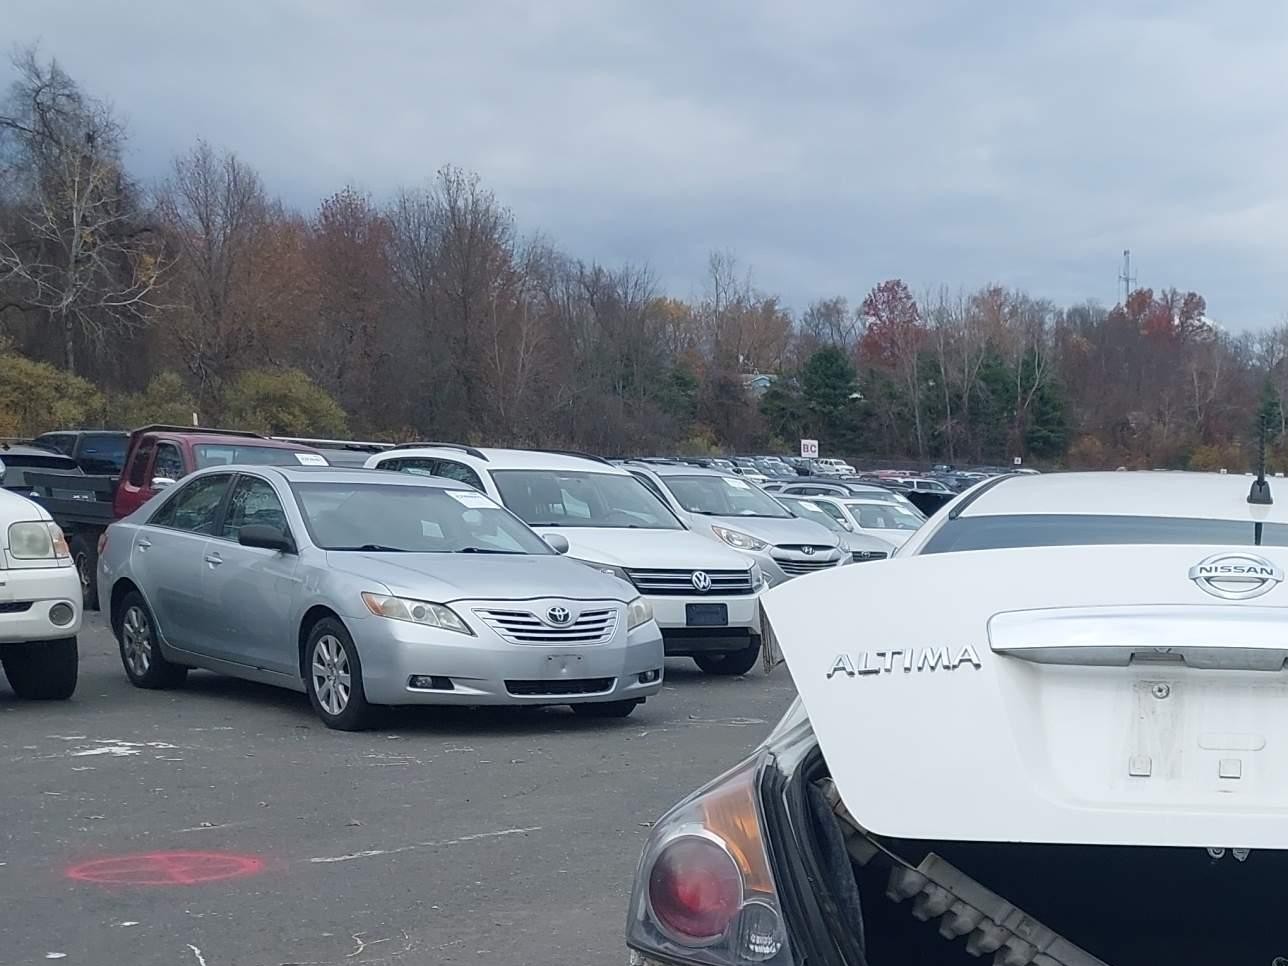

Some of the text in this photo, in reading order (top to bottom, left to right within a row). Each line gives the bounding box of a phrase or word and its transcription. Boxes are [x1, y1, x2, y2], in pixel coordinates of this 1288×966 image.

[803, 444, 816, 453] BC
[1200, 566, 1273, 575] NISSAN
[826, 645, 981, 679] ALTIMA
